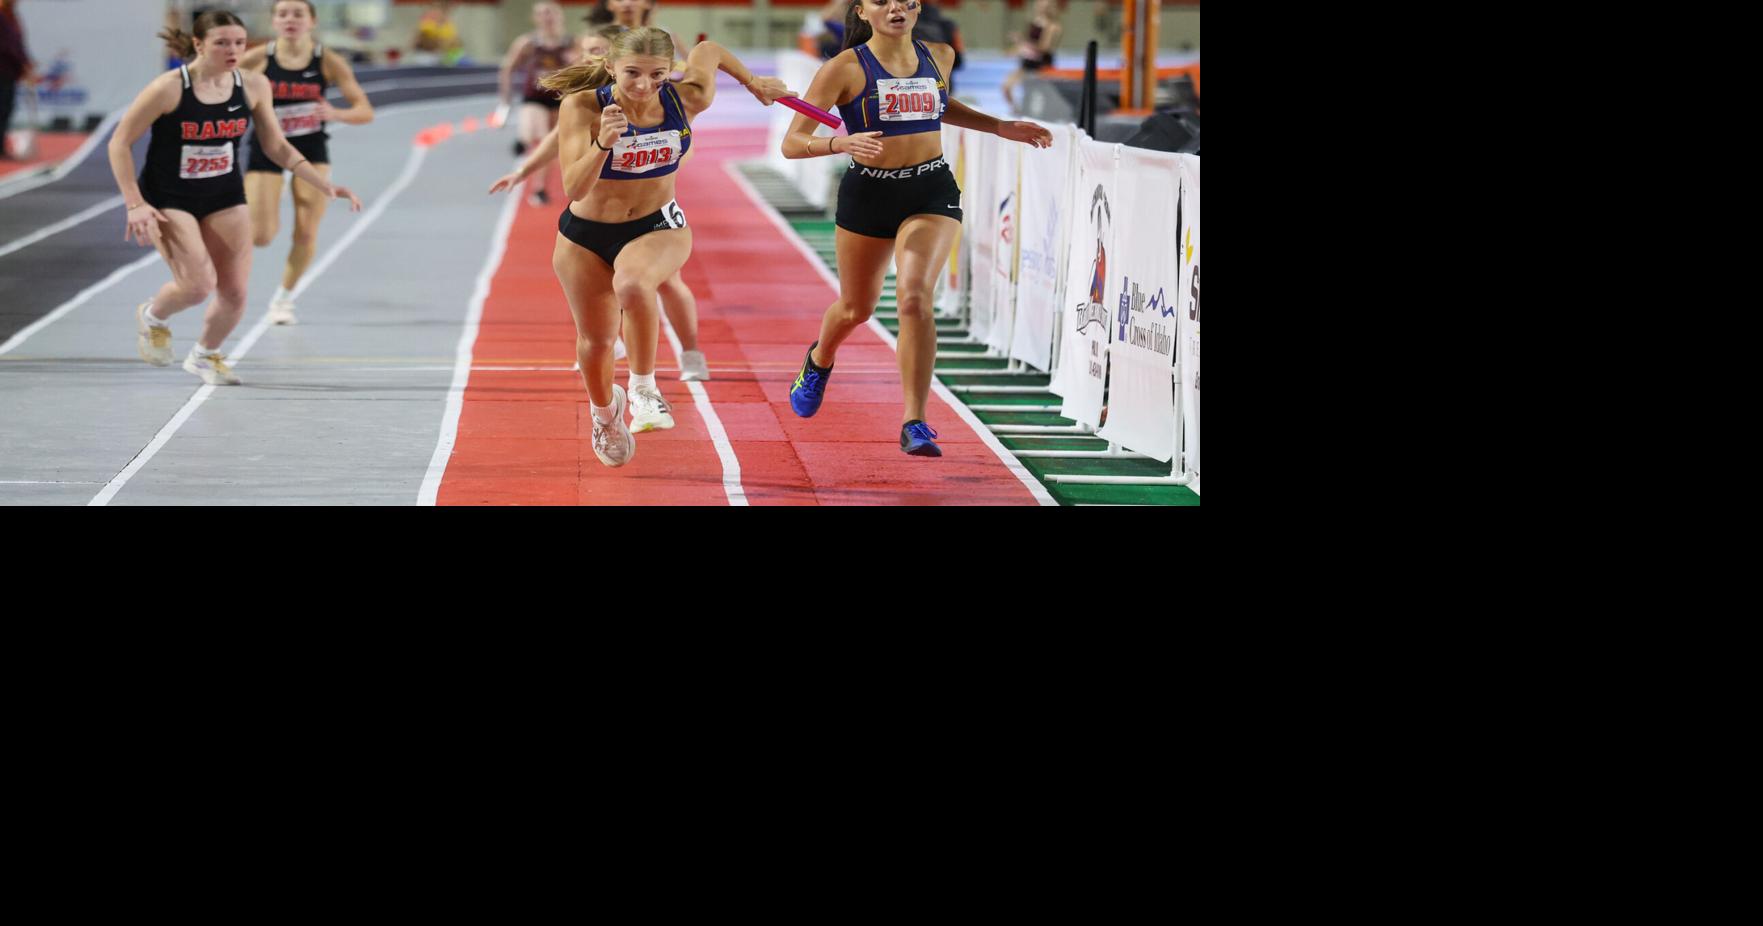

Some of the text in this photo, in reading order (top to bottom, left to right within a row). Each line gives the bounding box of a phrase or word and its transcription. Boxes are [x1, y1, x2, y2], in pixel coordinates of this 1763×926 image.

[885, 93, 935, 114] 2009
[181, 118, 248, 141] RAMS
[622, 147, 673, 169] 2013
[861, 167, 914, 179] NIKE
[669, 201, 685, 228] 6
[1131, 282, 1146, 313] Blue
[1129, 316, 1147, 349] Cross
[1147, 322, 1155, 351] of
[1153, 322, 1171, 356] Idaho
